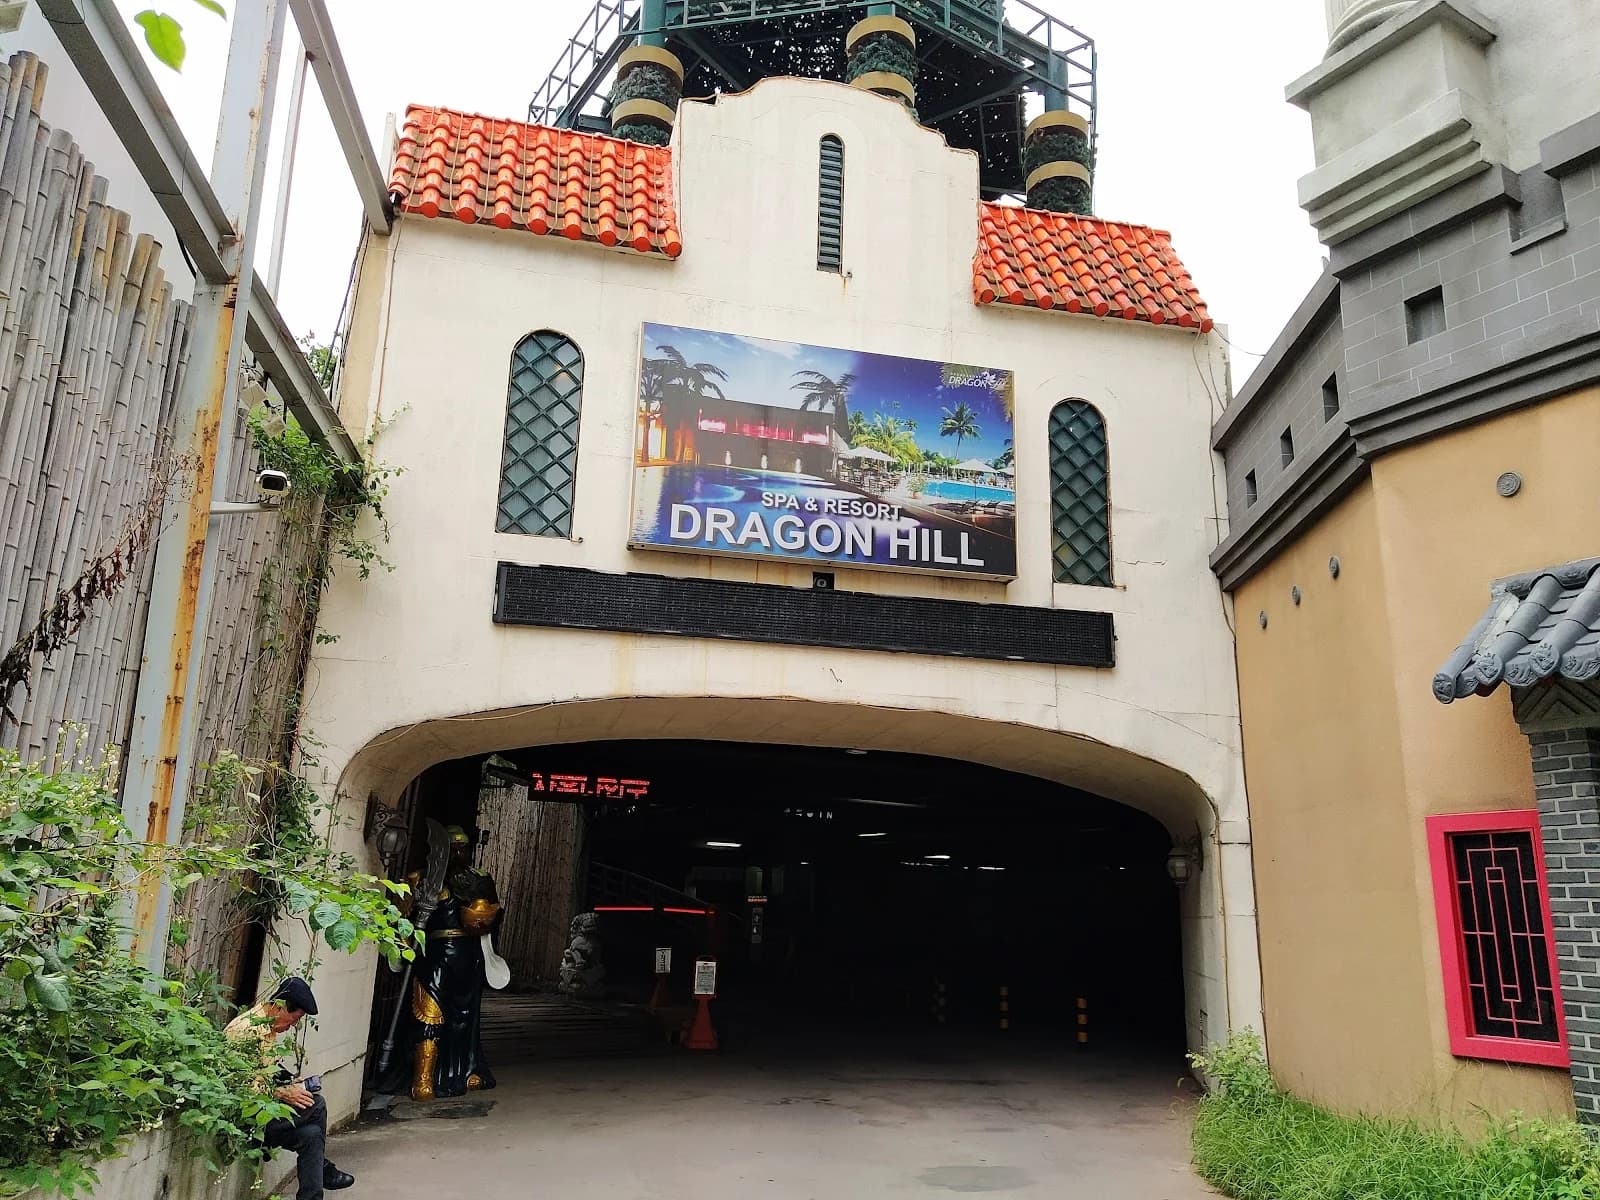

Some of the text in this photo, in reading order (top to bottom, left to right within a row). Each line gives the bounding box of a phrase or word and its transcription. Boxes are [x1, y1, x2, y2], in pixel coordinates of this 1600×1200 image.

[948, 375, 987, 390] DRAGON
[761, 491, 903, 521] SPA & RESORT
[669, 503, 985, 567] DRAGON HILL
